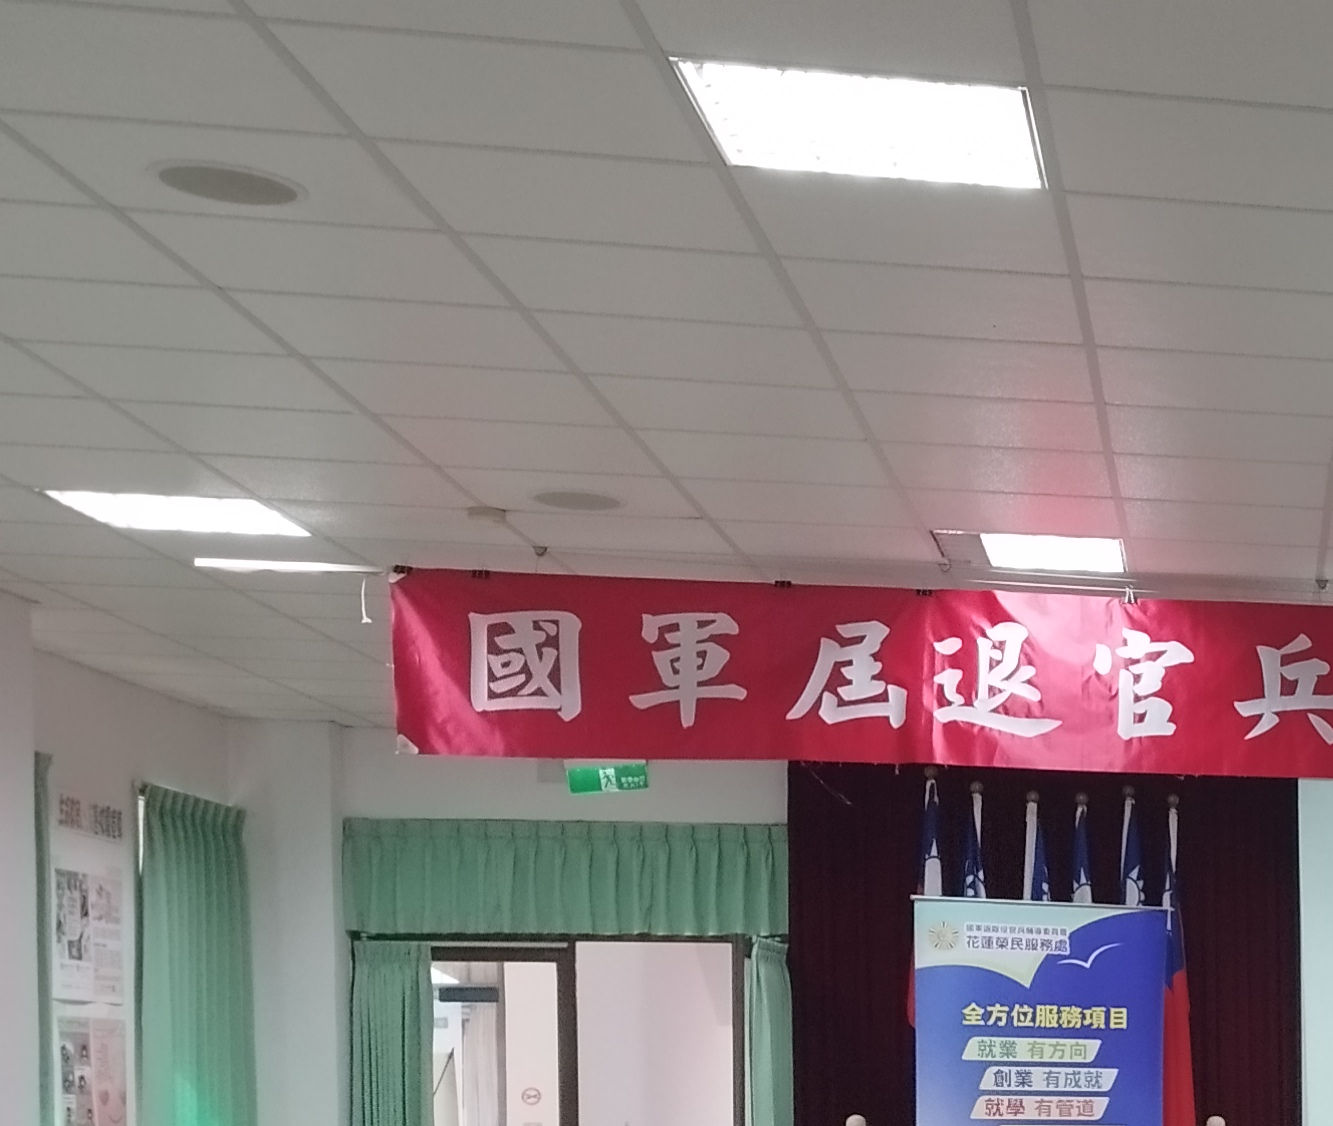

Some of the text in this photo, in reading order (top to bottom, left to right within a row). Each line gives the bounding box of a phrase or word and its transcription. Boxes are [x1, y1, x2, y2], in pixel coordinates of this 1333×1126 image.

[966, 935, 1068, 952] 花蓮榮民服務處
[961, 1002, 1128, 1030] 全方位服務項目
[977, 1039, 1087, 1060] 就業 有方向
[993, 1069, 1103, 1089] 創業 有成就
[985, 1098, 1095, 1117] 就學 有管道
